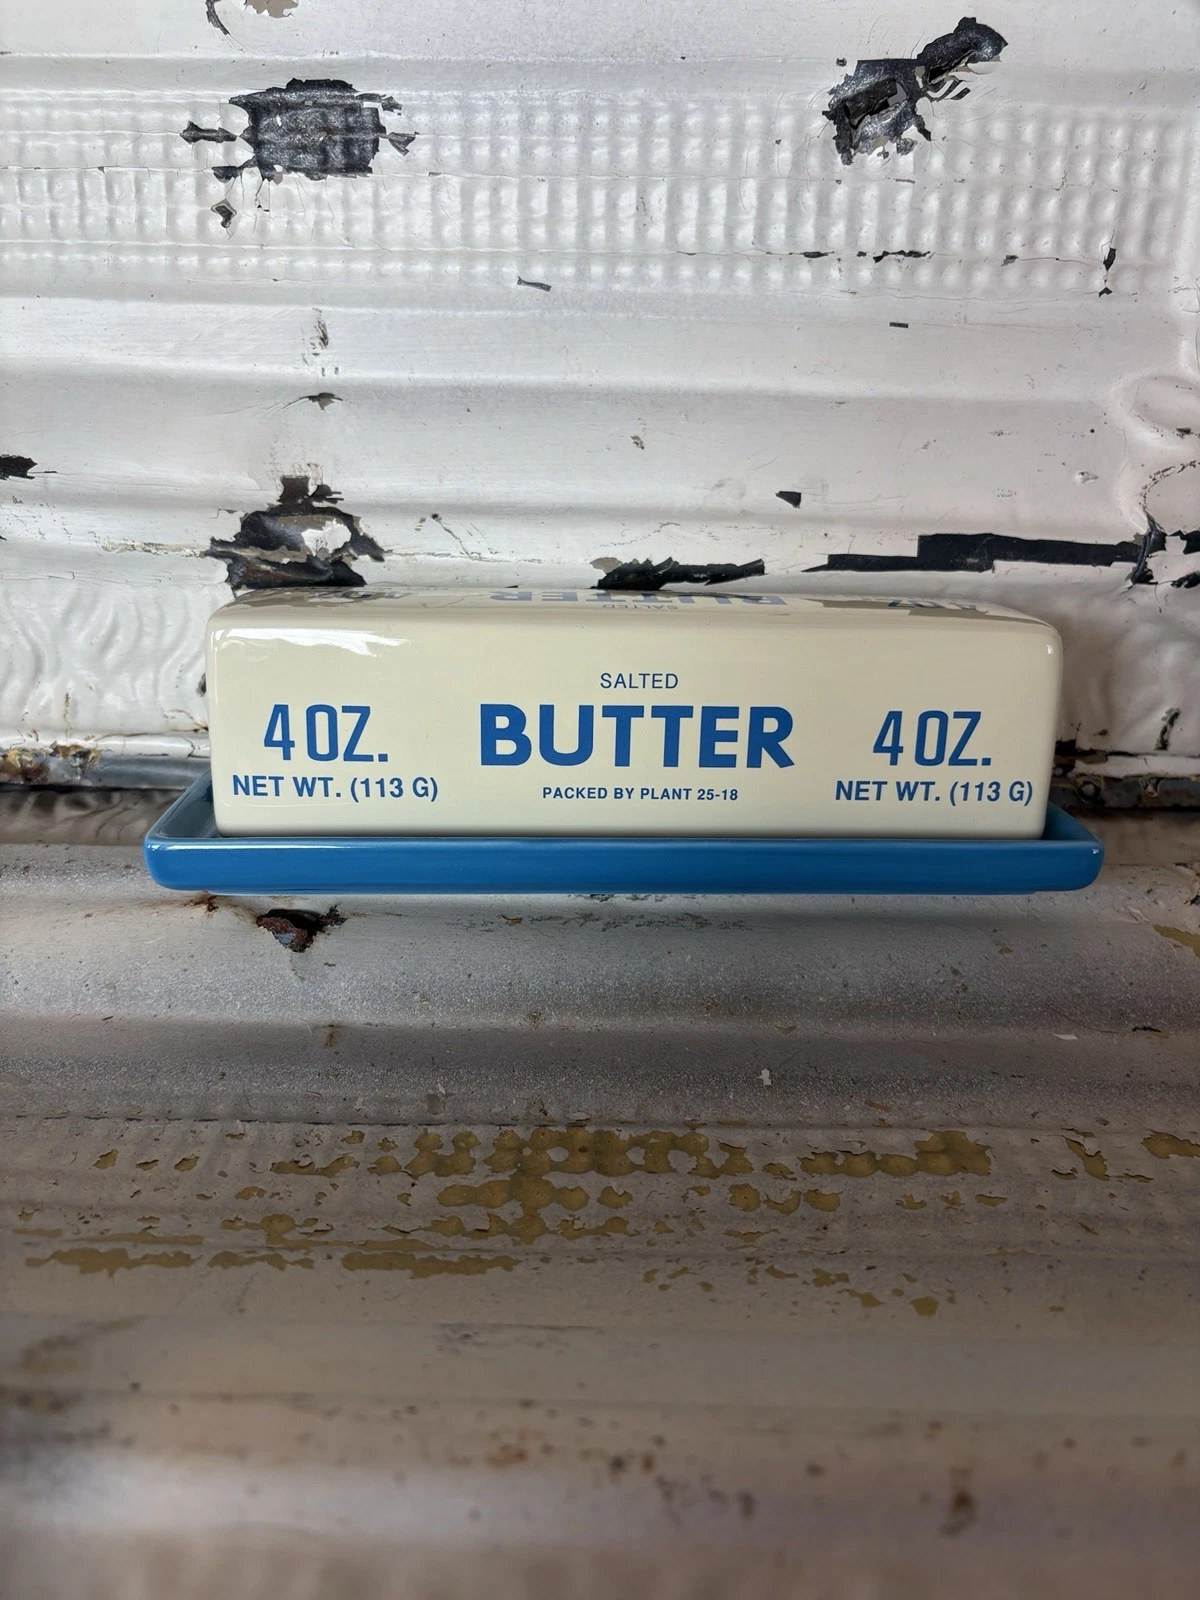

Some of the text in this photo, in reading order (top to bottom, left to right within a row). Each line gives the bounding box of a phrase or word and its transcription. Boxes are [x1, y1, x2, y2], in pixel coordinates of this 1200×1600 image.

[600, 672, 679, 689] SALTED
[479, 702, 795, 768] BUTTER
[232, 774, 439, 803] NET WT. (113 G)
[542, 786, 739, 802] PACKED BY PLANT 25-18
[834, 780, 1033, 806] NET WT. (113 G)
